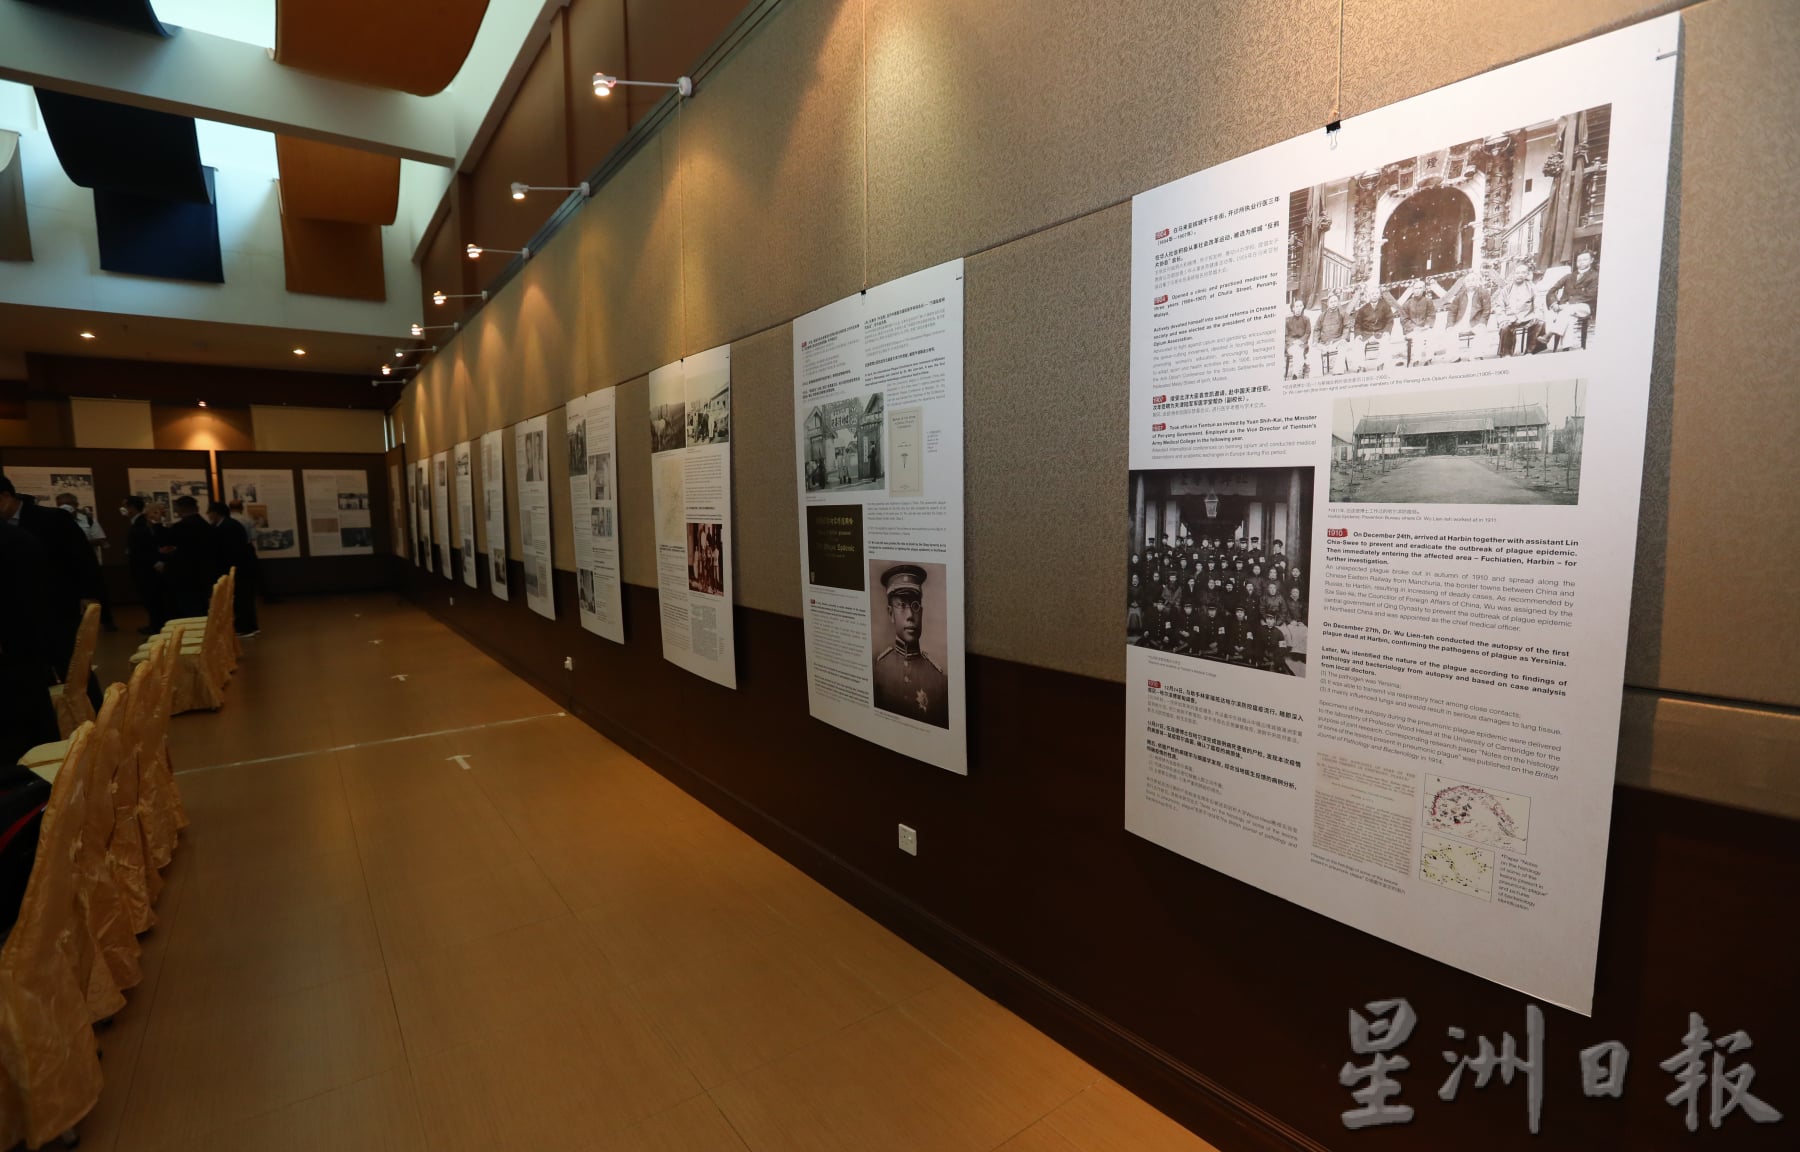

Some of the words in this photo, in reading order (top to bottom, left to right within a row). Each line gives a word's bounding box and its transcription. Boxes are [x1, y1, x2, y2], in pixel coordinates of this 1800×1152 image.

[1342, 548, 1380, 556] immediately
[1480, 555, 1524, 564] Fuchiatien,
[1505, 547, 1533, 555] plague
[1564, 600, 1574, 608] by
[1332, 622, 1363, 631] December
[1365, 626, 1380, 634] 27th,
[1406, 631, 1435, 640] Lien-teh
[1436, 636, 1475, 645] conducted
[1491, 643, 1523, 652] autopsy
[1391, 639, 1427, 649] confirming
[1441, 646, 1480, 655] pathogens
[1490, 652, 1517, 660] plague
[1530, 656, 1567, 666] Yersinia.
[1322, 655, 1350, 664] pathology
[1365, 660, 1405, 672] bacteriology
[1425, 671, 1453, 680] autopsy
[1471, 676, 1495, 685] based
[1532, 687, 1566, 696] analysis
[1351, 650, 1381, 659] identified
[1442, 664, 1467, 672] plague
[1469, 668, 1508, 679] according
[1522, 674, 1555, 685] findings
[1351, 666, 1377, 675] doctors.
